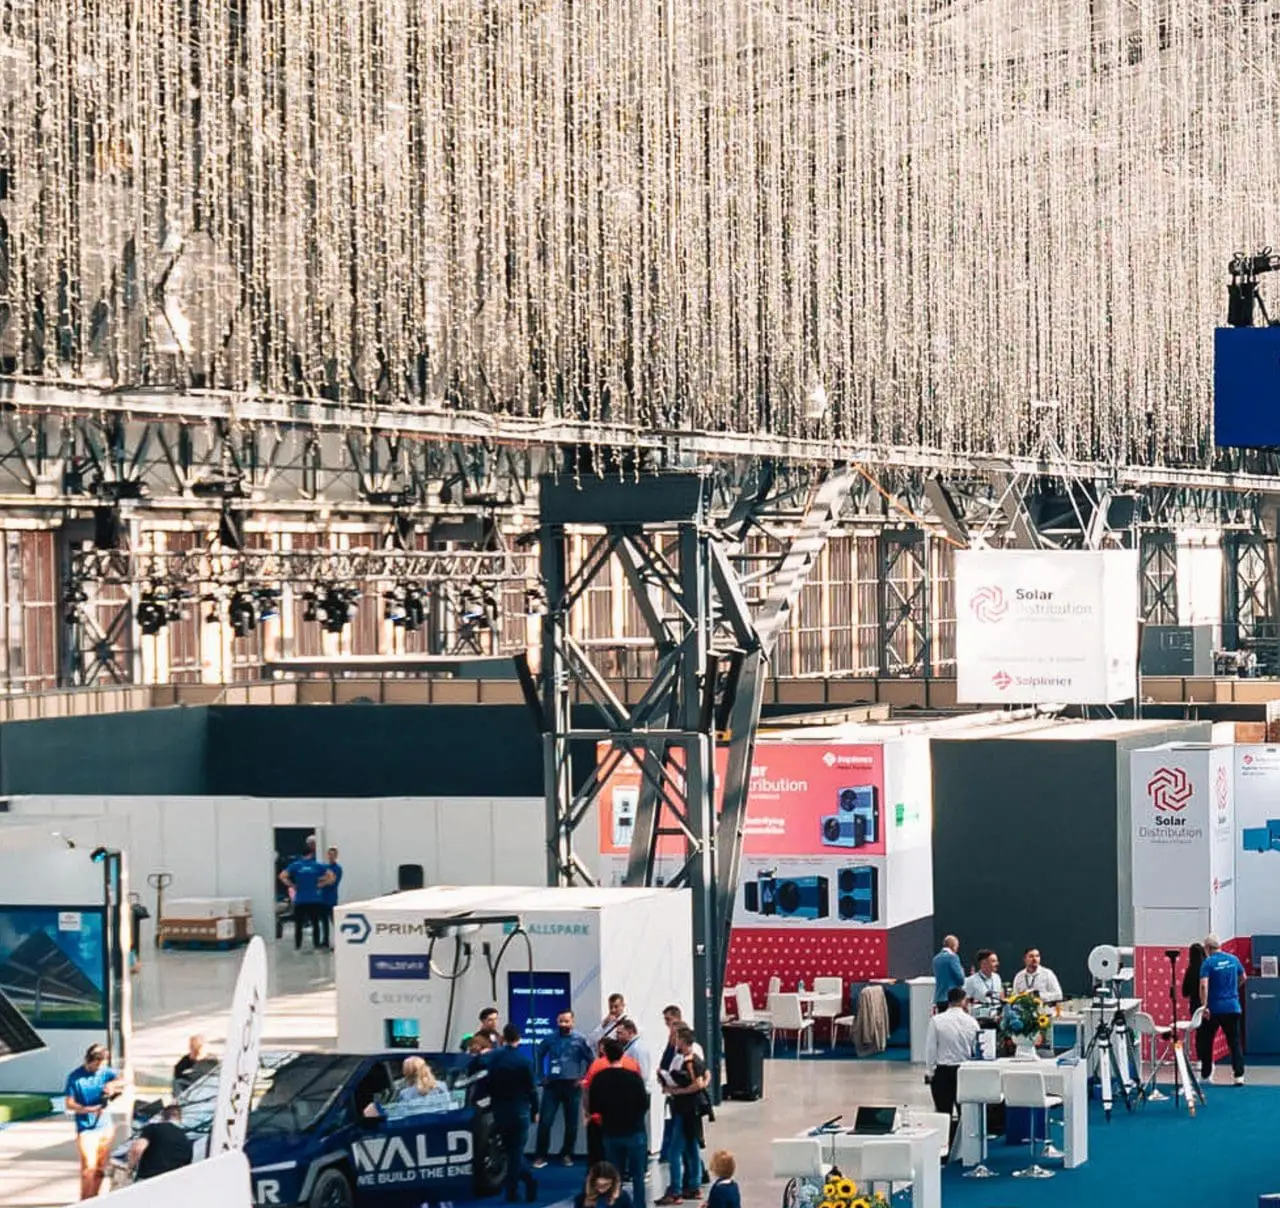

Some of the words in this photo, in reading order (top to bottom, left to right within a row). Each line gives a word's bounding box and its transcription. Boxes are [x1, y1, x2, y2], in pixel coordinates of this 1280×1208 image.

[1016, 588, 1054, 600] Solar
[1155, 815, 1186, 826] Solar
[1138, 827, 1202, 838] Distribution
[528, 924, 589, 936] ALLSPARK
[377, 1169, 416, 1184] BUILD
[420, 1167, 444, 1178] THE
